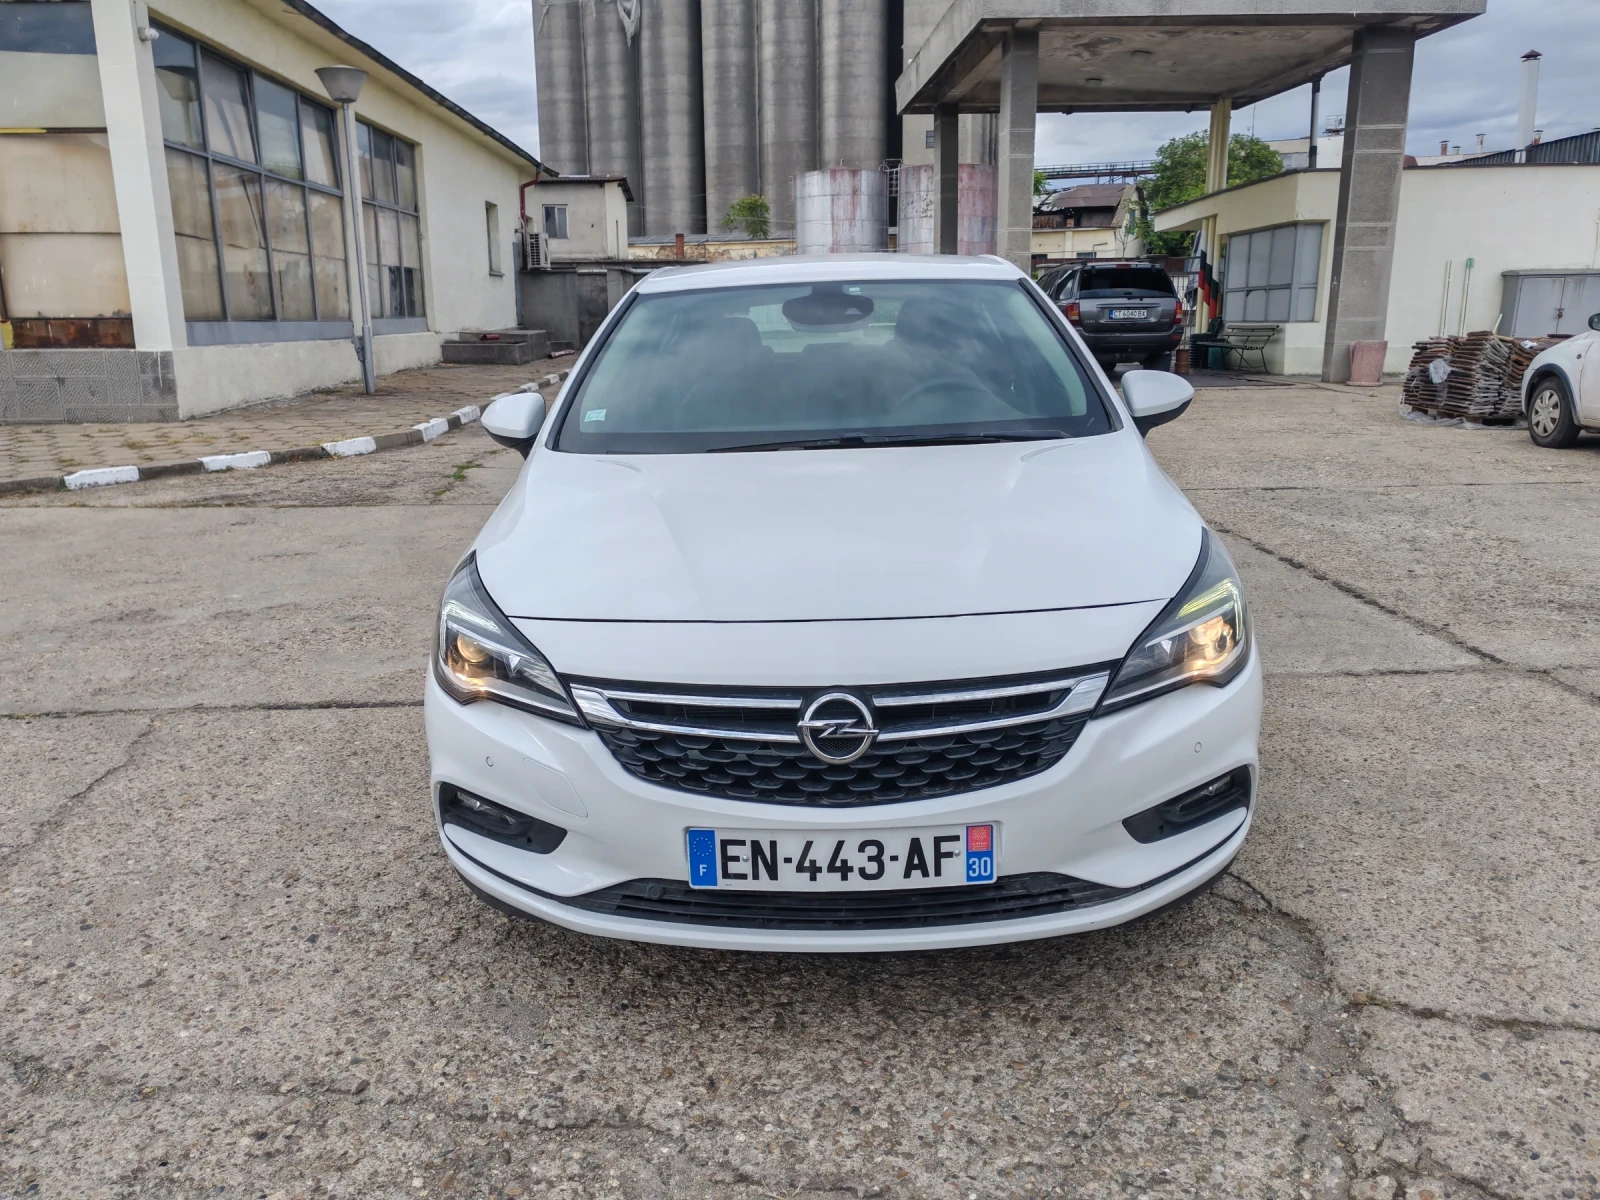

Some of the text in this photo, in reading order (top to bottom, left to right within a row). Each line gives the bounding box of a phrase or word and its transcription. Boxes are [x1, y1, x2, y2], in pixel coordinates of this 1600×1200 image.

[720, 835, 960, 881] EN-443-AF
[969, 857, 991, 877] 30
[699, 864, 707, 876] F
